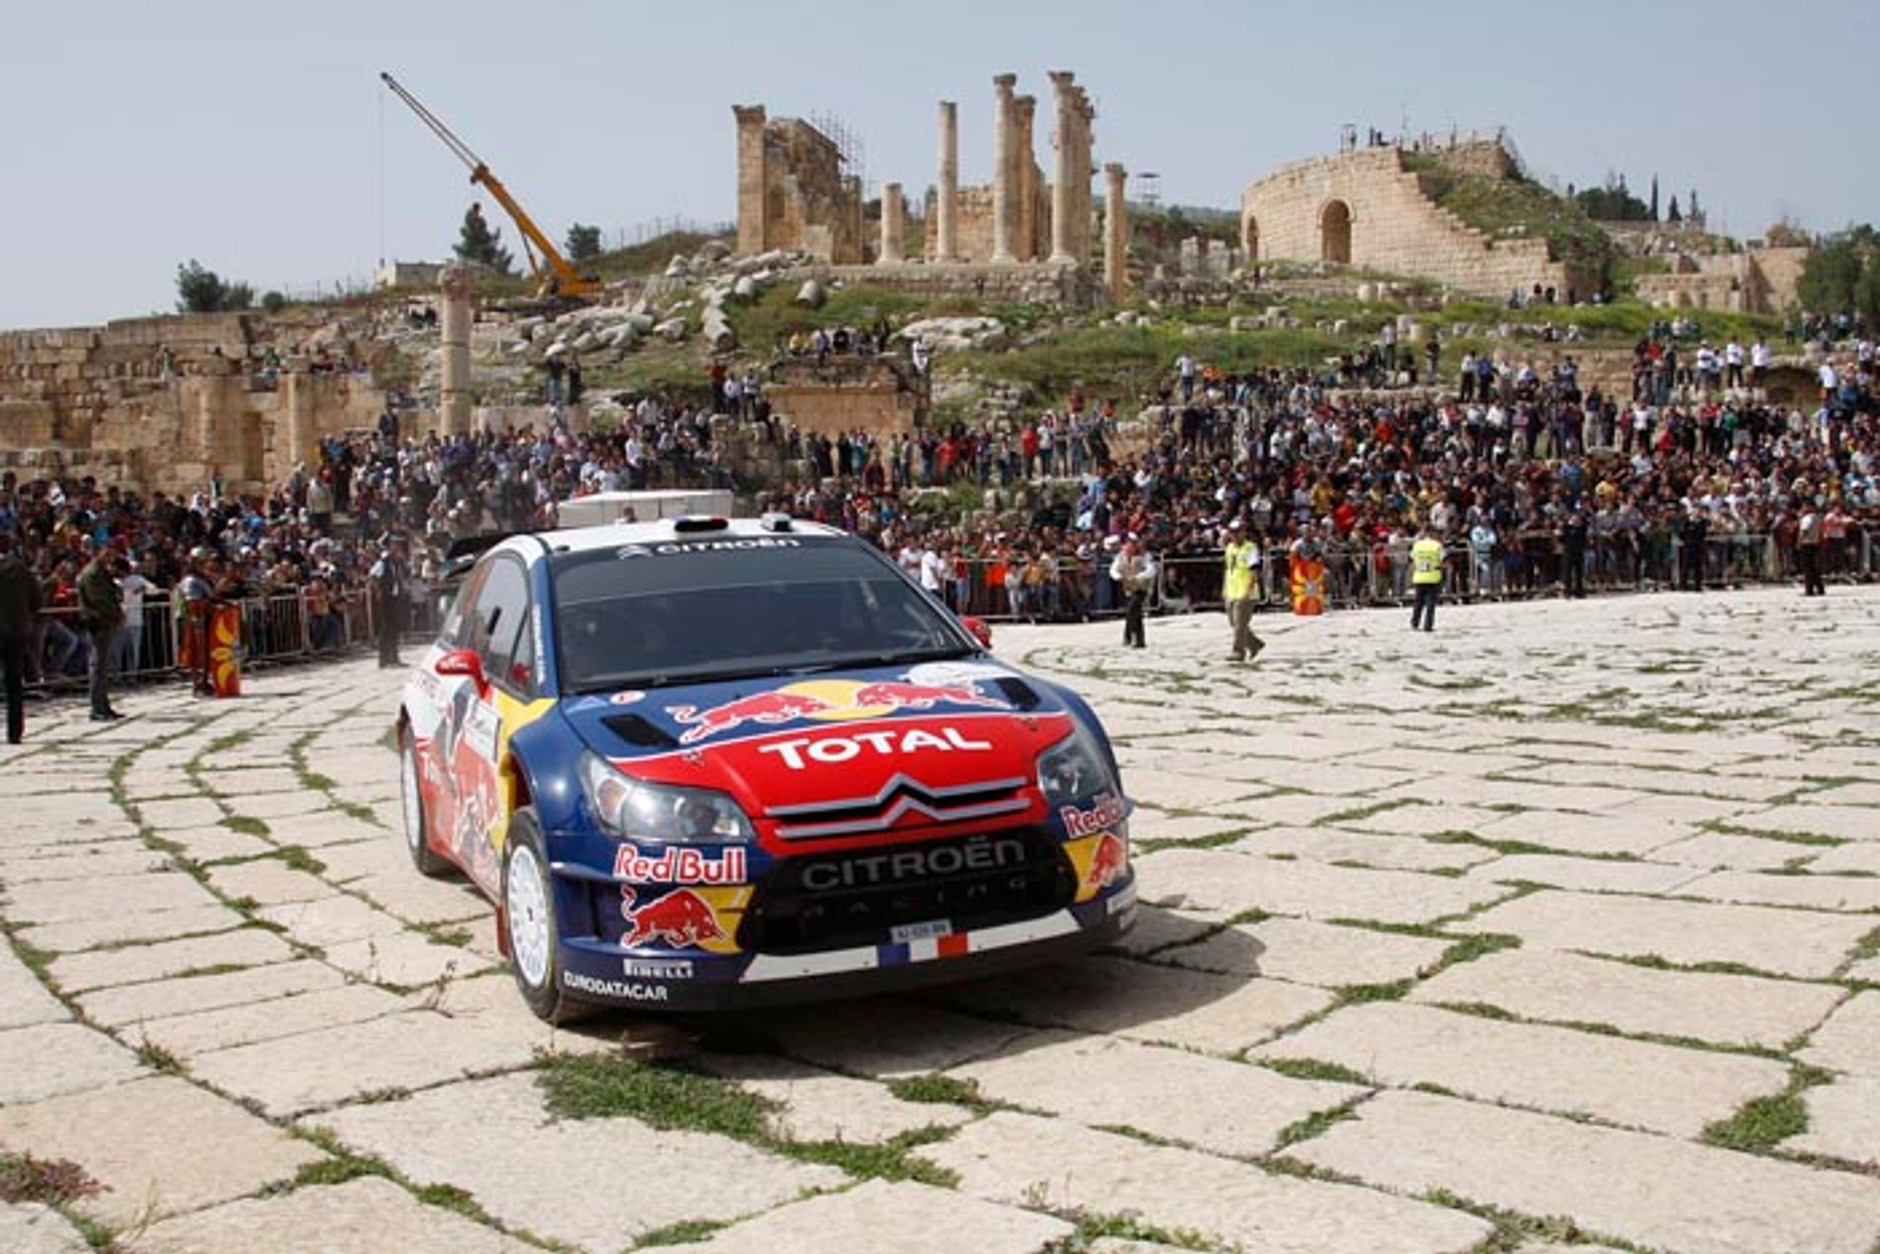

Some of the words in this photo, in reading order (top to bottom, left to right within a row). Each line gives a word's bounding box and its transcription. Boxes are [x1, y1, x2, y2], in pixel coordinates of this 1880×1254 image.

[758, 727, 993, 769] TOTAL
[613, 843, 675, 883] Red
[677, 846, 747, 883] Bull
[563, 969, 668, 1001] EURODATACAR
[624, 958, 693, 979] PIRELLI
